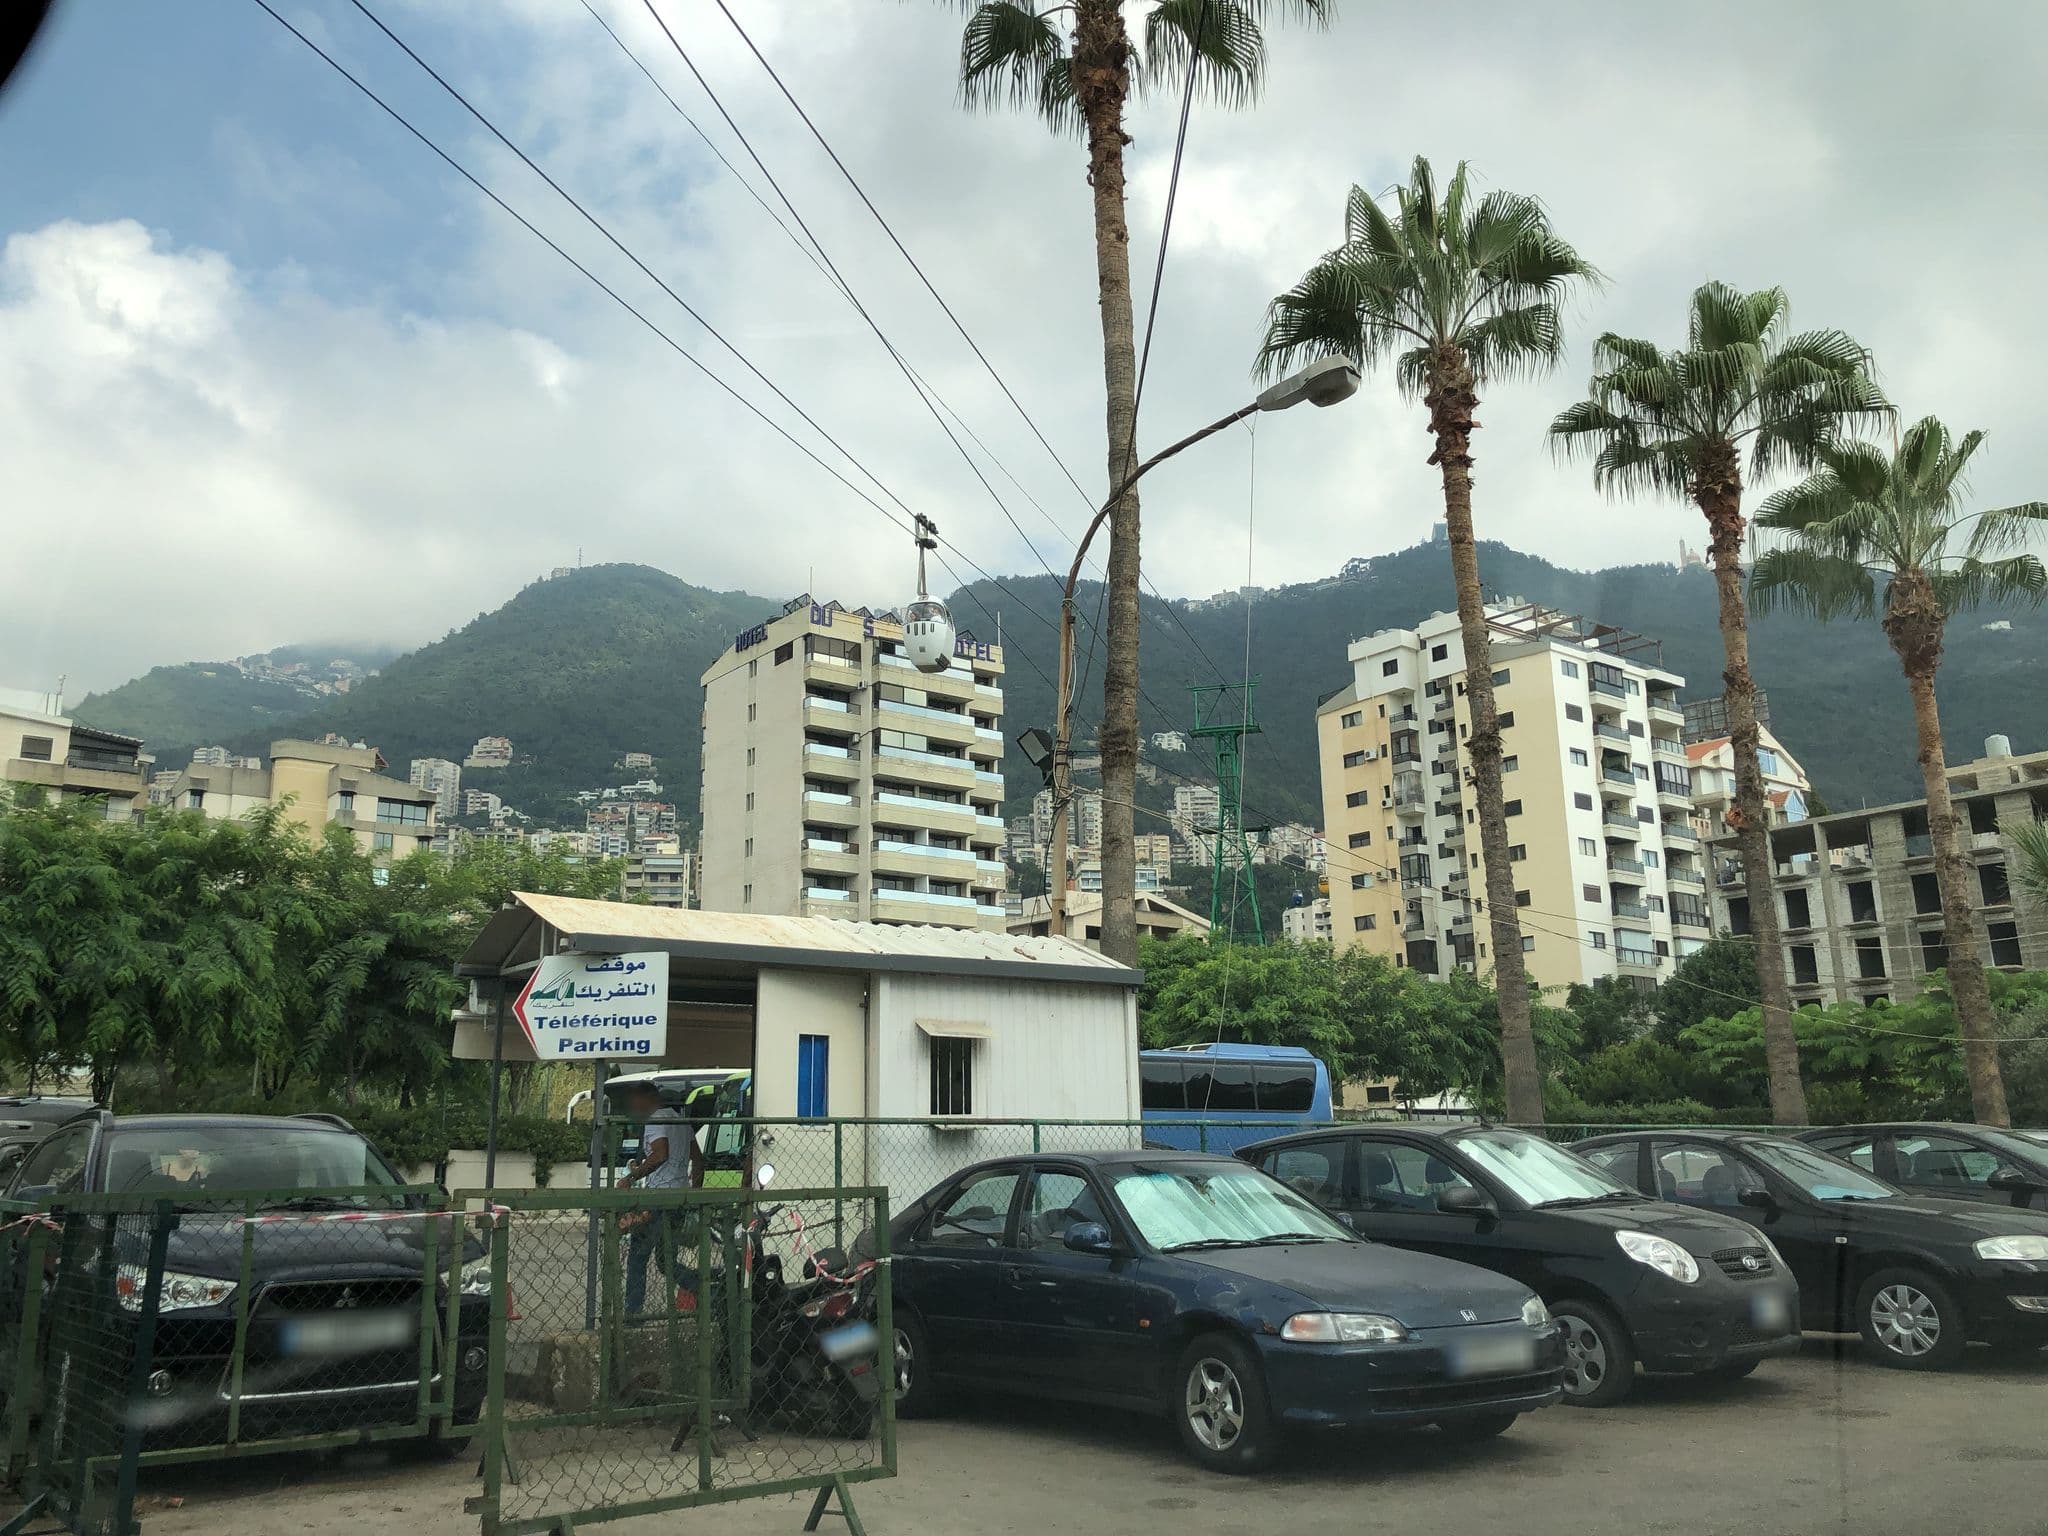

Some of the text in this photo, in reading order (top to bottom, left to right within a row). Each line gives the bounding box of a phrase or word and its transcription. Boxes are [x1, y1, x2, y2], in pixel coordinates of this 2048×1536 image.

[953, 635, 996, 663] OTEL
[585, 957, 646, 974] موقف
[575, 982, 656, 1002] التلفريك
[534, 1013, 658, 1030] Téléférique
[558, 1036, 651, 1055] Parking
